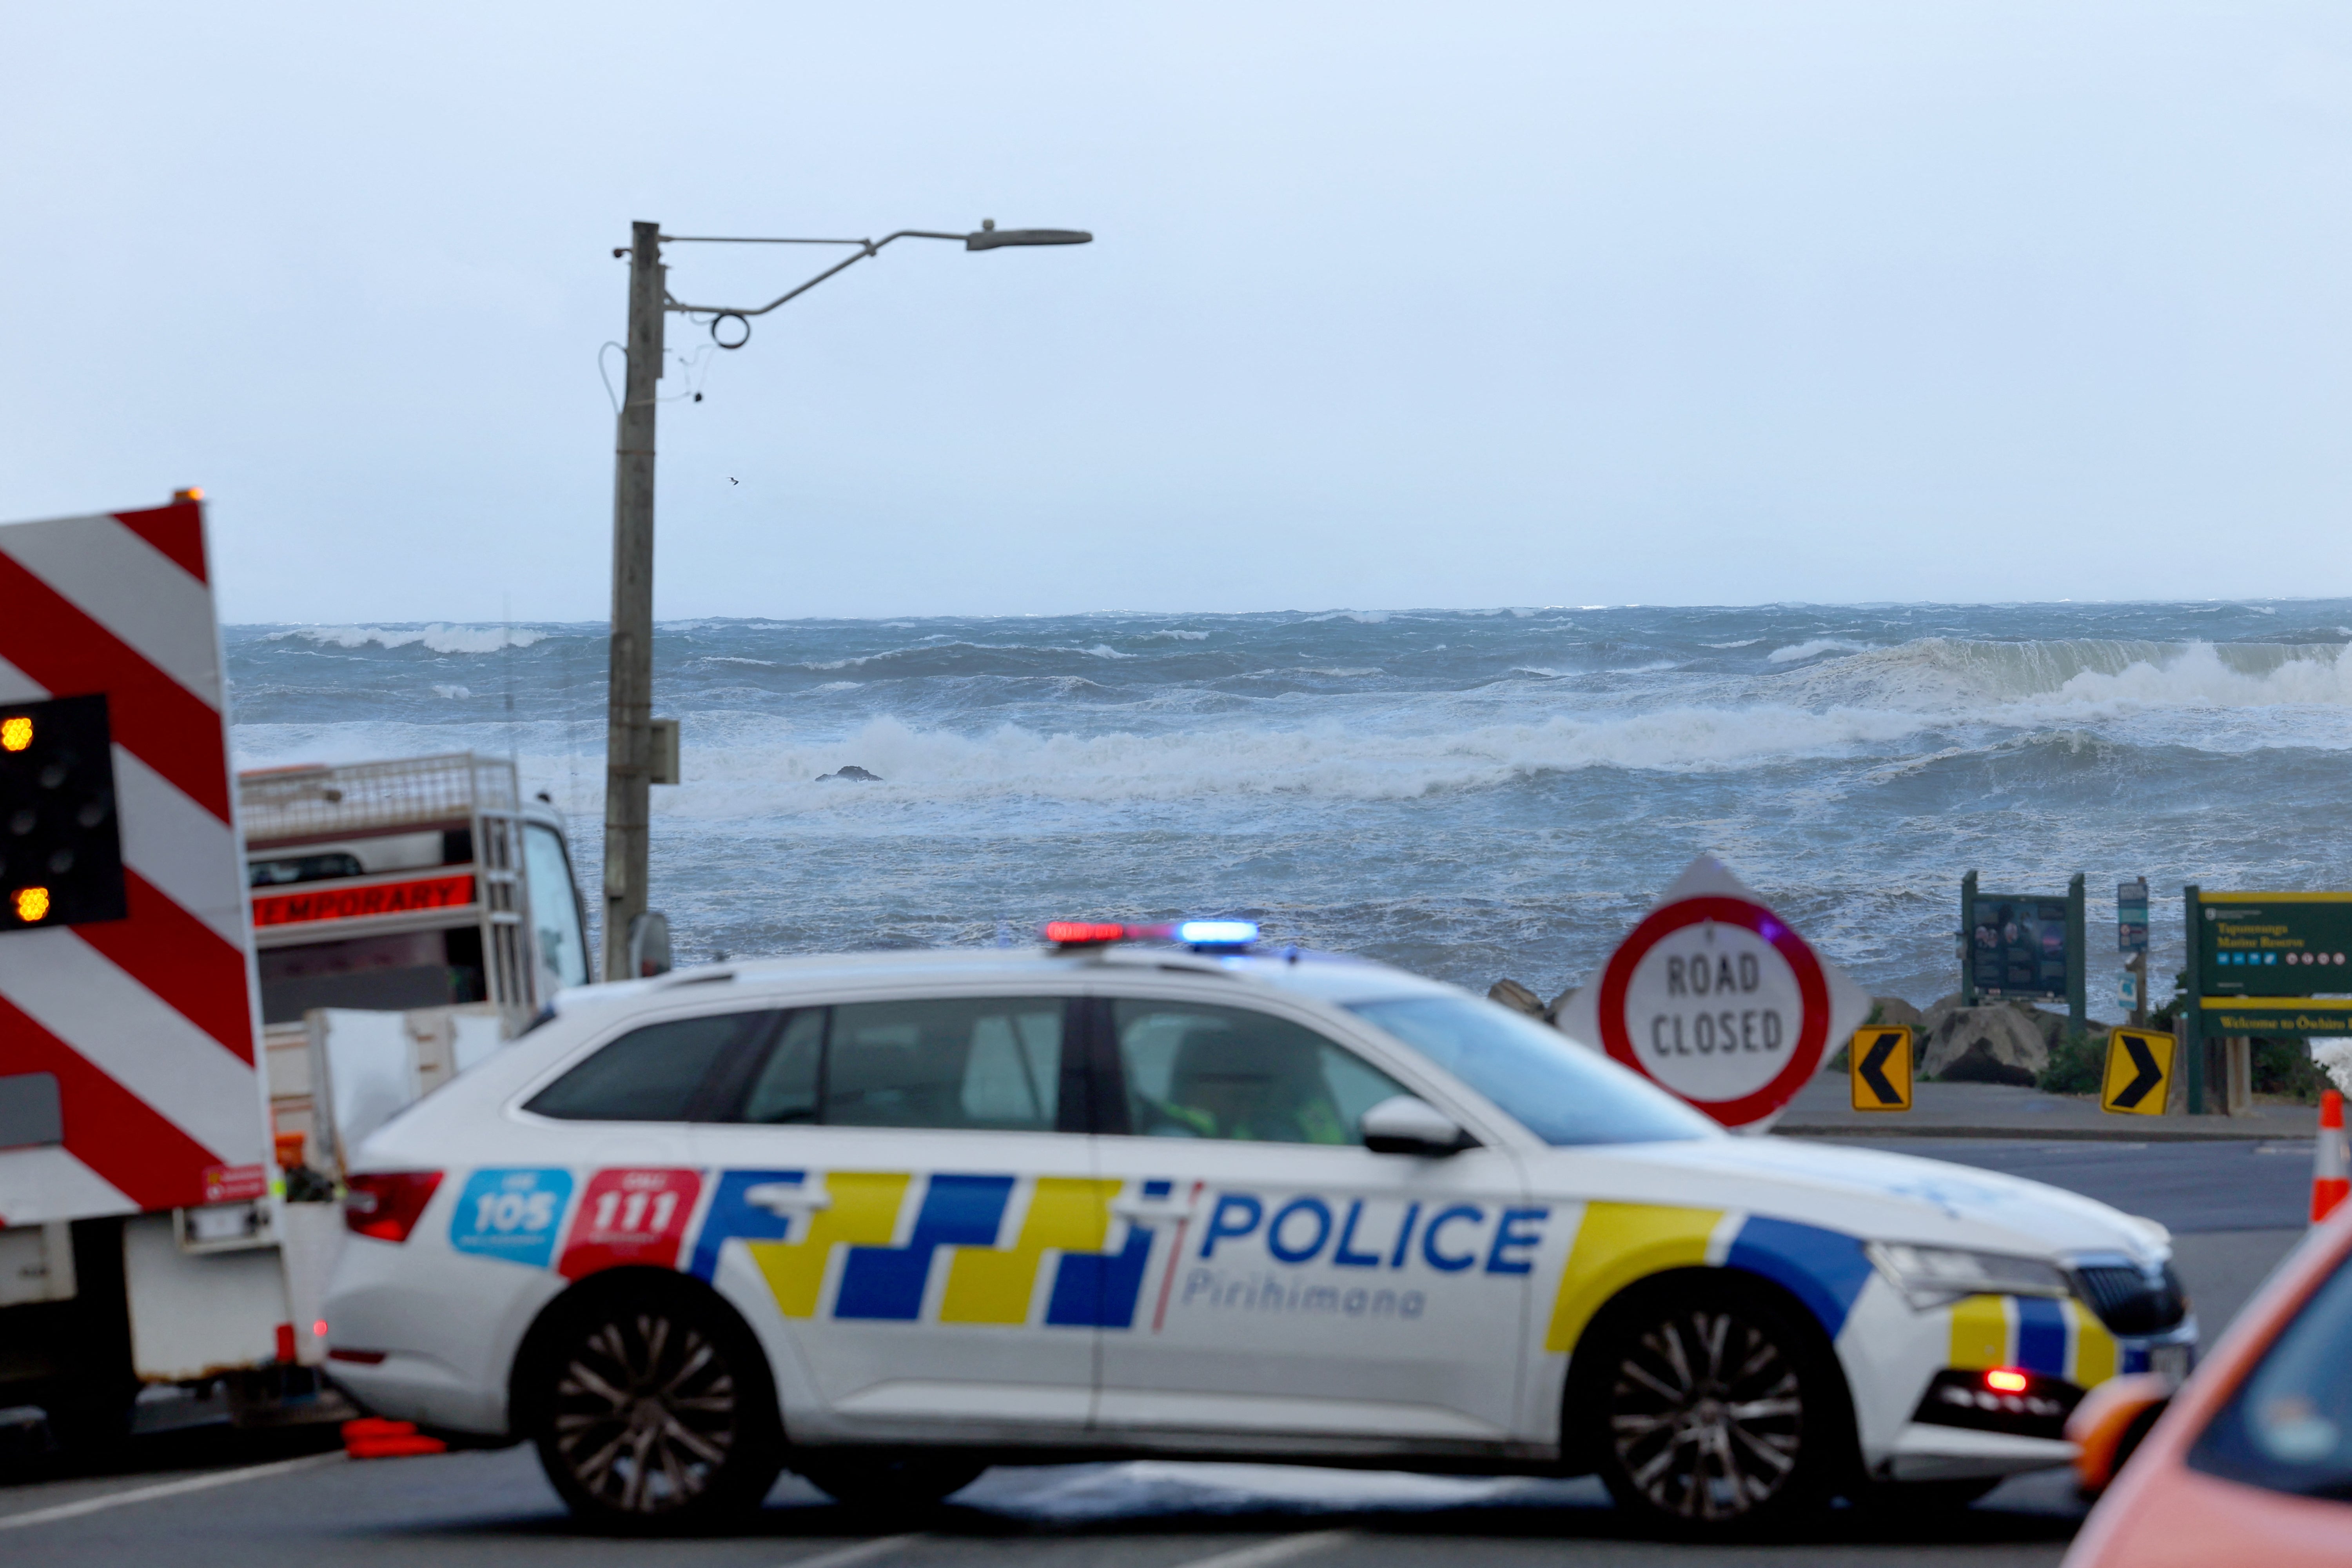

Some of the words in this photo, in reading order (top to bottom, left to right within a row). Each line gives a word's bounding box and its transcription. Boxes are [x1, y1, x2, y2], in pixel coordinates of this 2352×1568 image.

[1667, 952, 1759, 996] ROAD
[1652, 1009, 1782, 1056] CLOSED
[2220, 1016, 2278, 1029] Welcome
[2280, 1019, 2294, 1029] to
[475, 1192, 555, 1232] 105
[596, 1191, 678, 1232] 111
[1198, 1193, 1550, 1274] POLICE
[1181, 1269, 1427, 1318] Pirihimana
